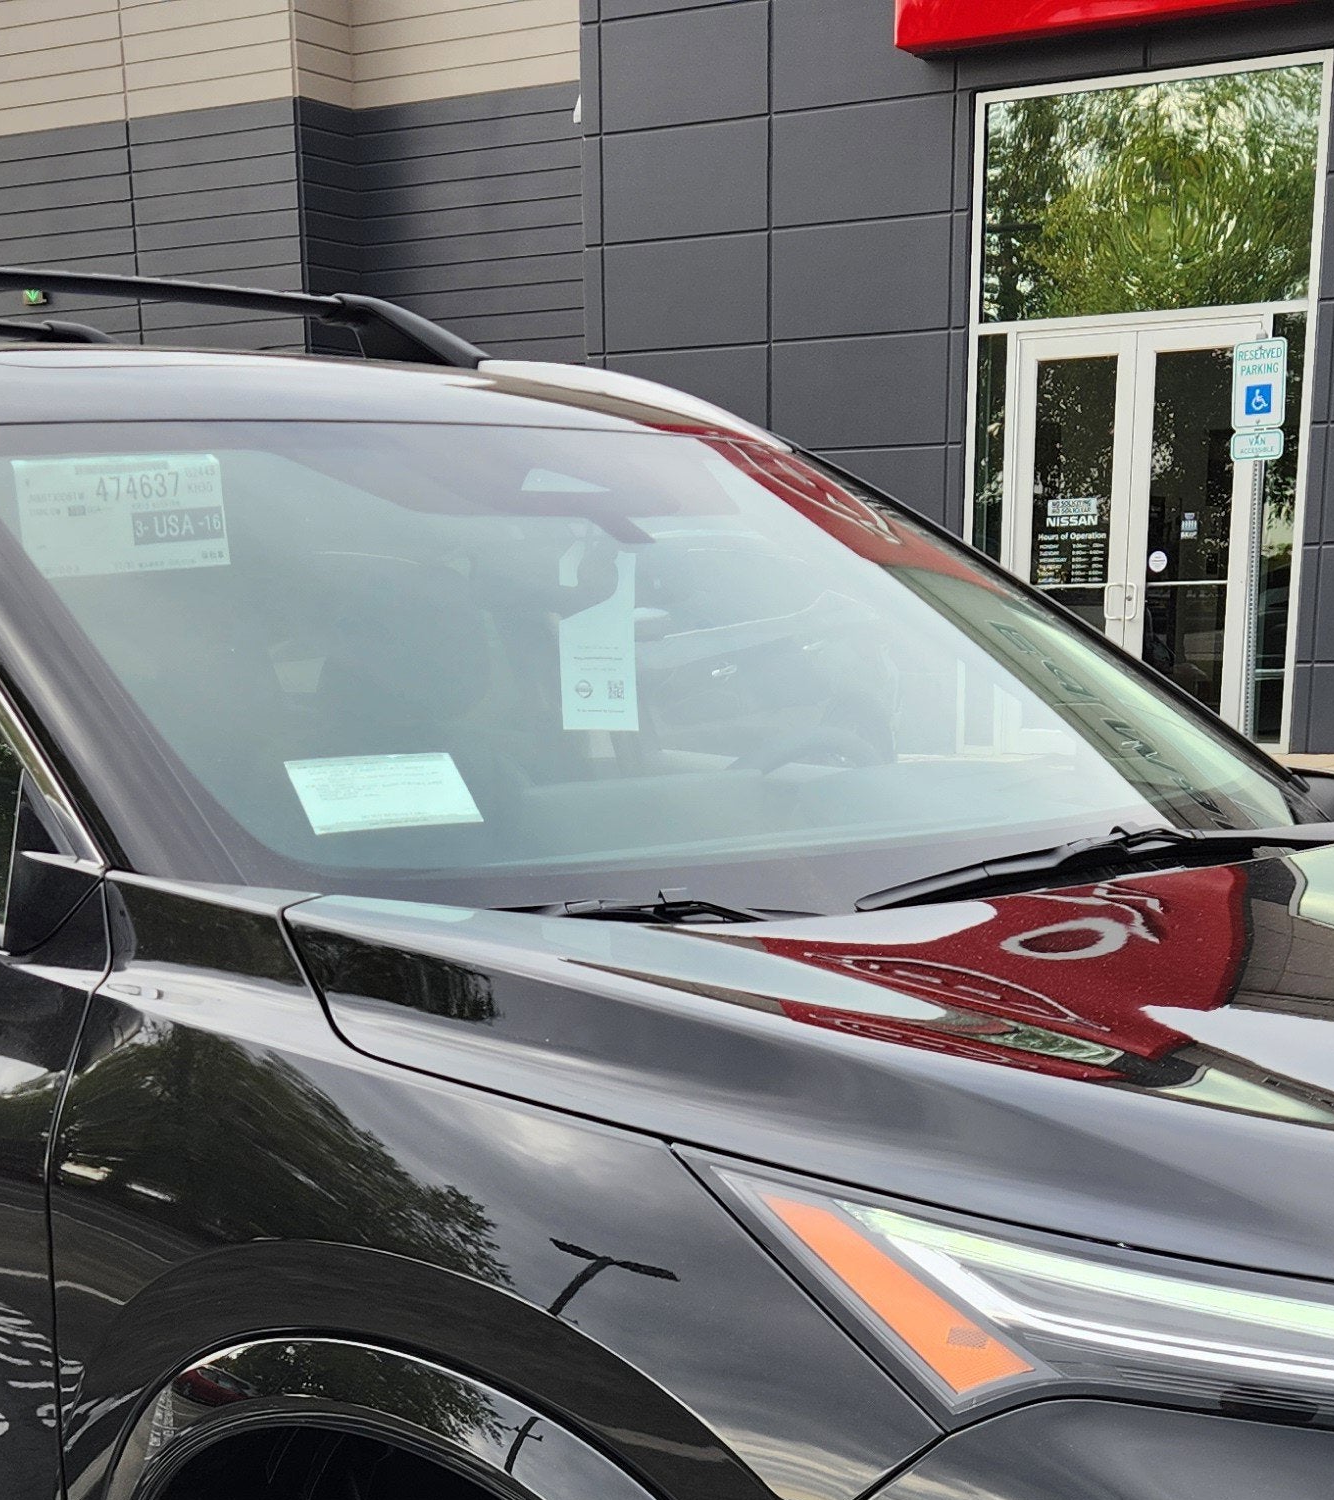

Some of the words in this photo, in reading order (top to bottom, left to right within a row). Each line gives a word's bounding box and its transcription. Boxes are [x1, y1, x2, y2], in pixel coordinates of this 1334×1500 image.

[1237, 348, 1283, 361] RESERVED
[1240, 362, 1279, 376] PARKING
[1248, 436, 1266, 446] VAN
[96, 471, 179, 502] 474637
[154, 513, 195, 538] USA
[1046, 515, 1098, 528] NISSAN
[1038, 533, 1059, 541] Hours
[1060, 532, 1069, 540] of
[1069, 531, 1107, 541] Operation
